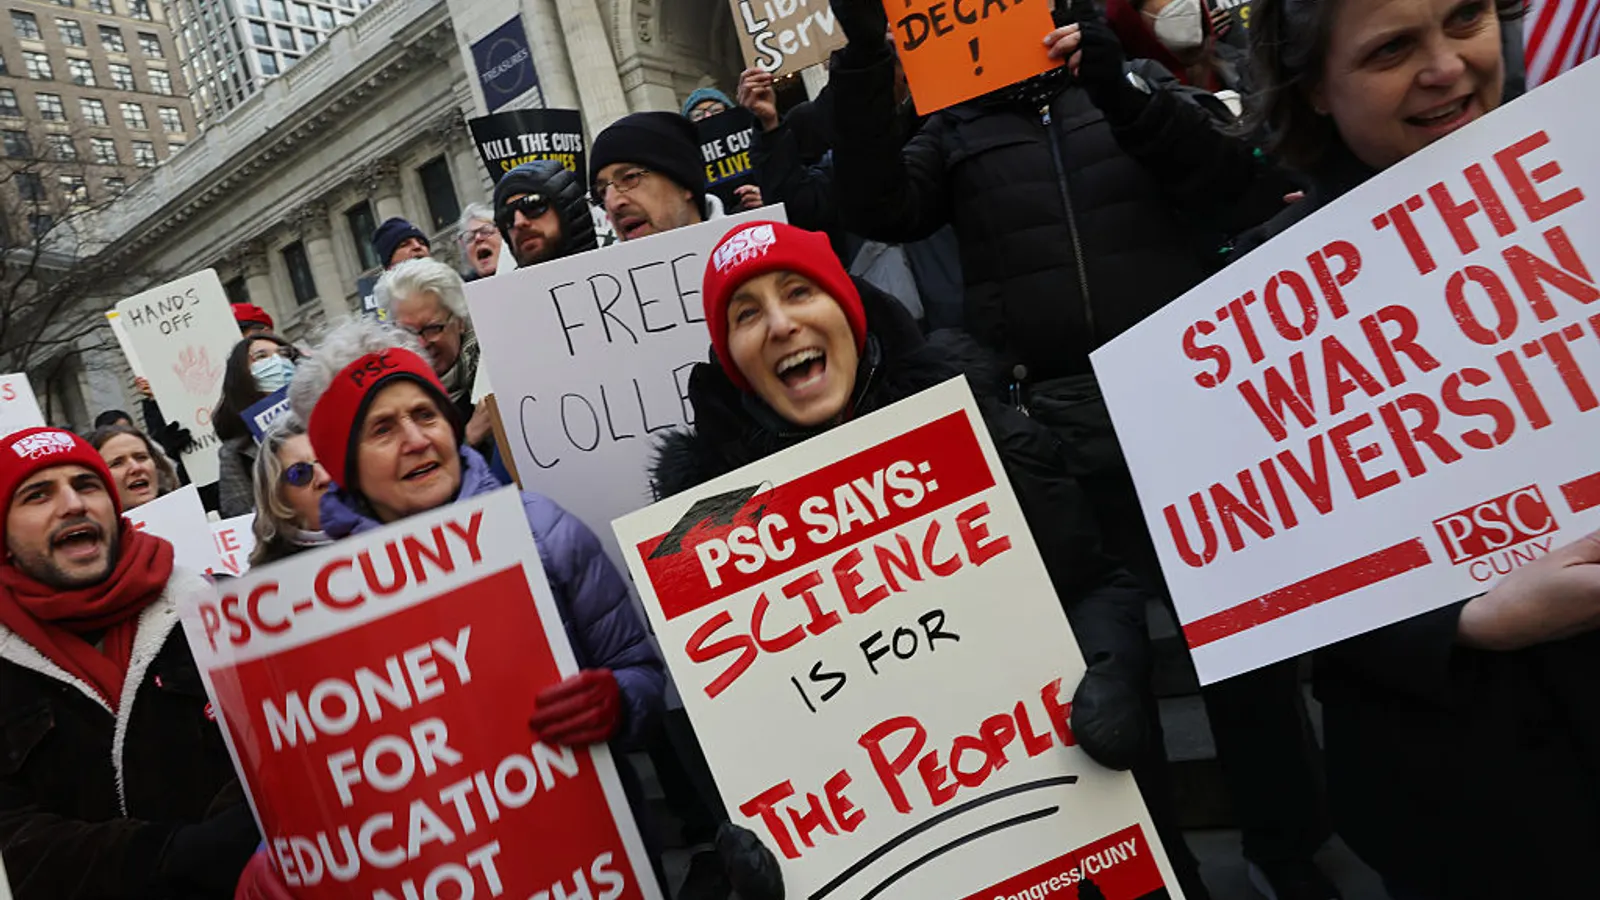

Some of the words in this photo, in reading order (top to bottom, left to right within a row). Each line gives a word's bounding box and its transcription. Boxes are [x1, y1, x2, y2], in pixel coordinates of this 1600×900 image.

[740, 0, 807, 34] Lib
[897, 0, 1026, 51] DECA
[482, 138, 517, 160] KILL
[517, 133, 551, 153] THE
[551, 132, 583, 152] CUTS
[716, 226, 772, 266] PSC
[1182, 240, 1362, 388] STOP
[1372, 130, 1585, 275] THE
[128, 287, 200, 326] HANDS
[159, 312, 194, 335] OFF
[549, 253, 706, 356] FREE
[1238, 304, 1441, 443] WAR
[1445, 225, 1600, 345] ON
[351, 355, 400, 388] PSC
[1163, 313, 1600, 567] UNIVERSIT
[695, 513, 797, 589] PSC
[799, 460, 939, 544] SAYS:
[1435, 487, 1552, 563] PSC
[1469, 536, 1553, 582] CUNY
[199, 511, 484, 653] PSC-CUNY
[686, 501, 1012, 699] SCIENCE
[262, 624, 473, 752] MONEY
[791, 660, 846, 713] IS
[859, 609, 961, 675] FOR
[326, 716, 463, 808] FOR
[273, 742, 579, 887] EDUCATION
[739, 769, 867, 859] THE
[993, 837, 1138, 900] ngress/CUNY
